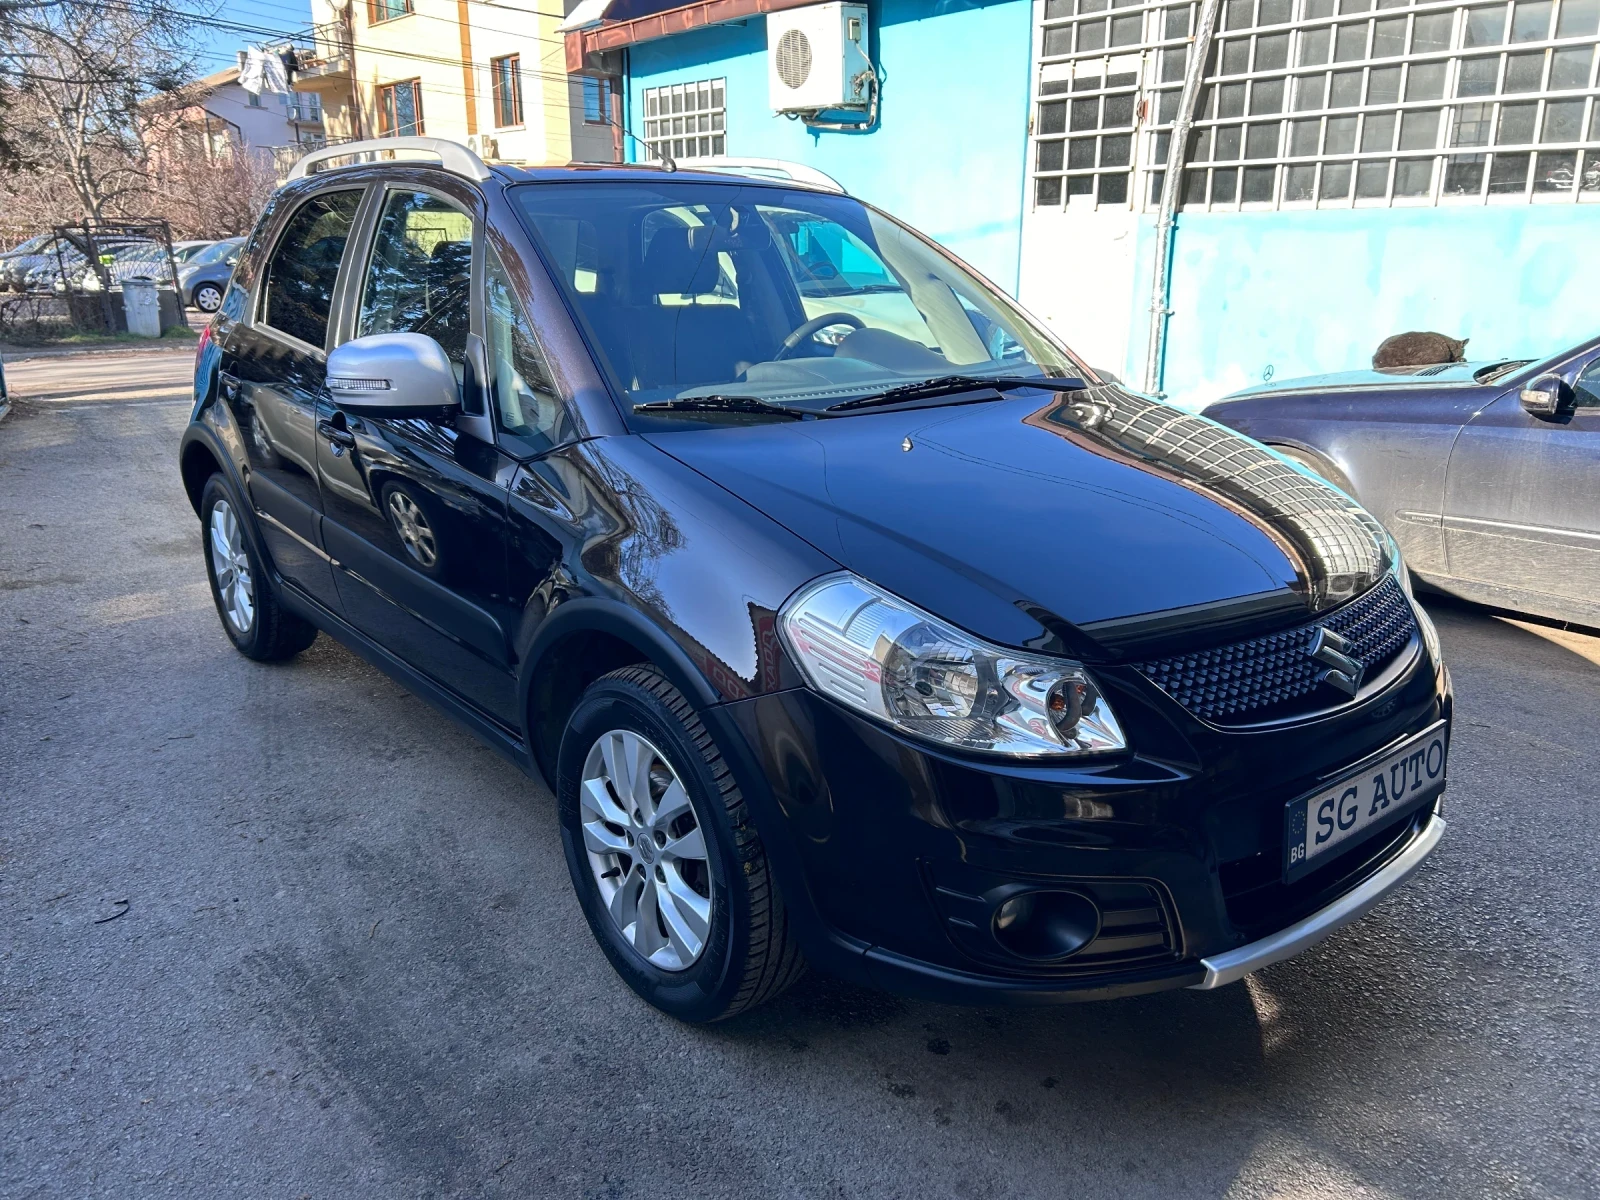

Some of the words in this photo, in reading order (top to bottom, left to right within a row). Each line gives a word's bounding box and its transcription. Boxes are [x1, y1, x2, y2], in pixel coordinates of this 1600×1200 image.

[1315, 785, 1359, 846] SG
[1368, 738, 1444, 817] AUTO
[1290, 842, 1305, 864] BG
